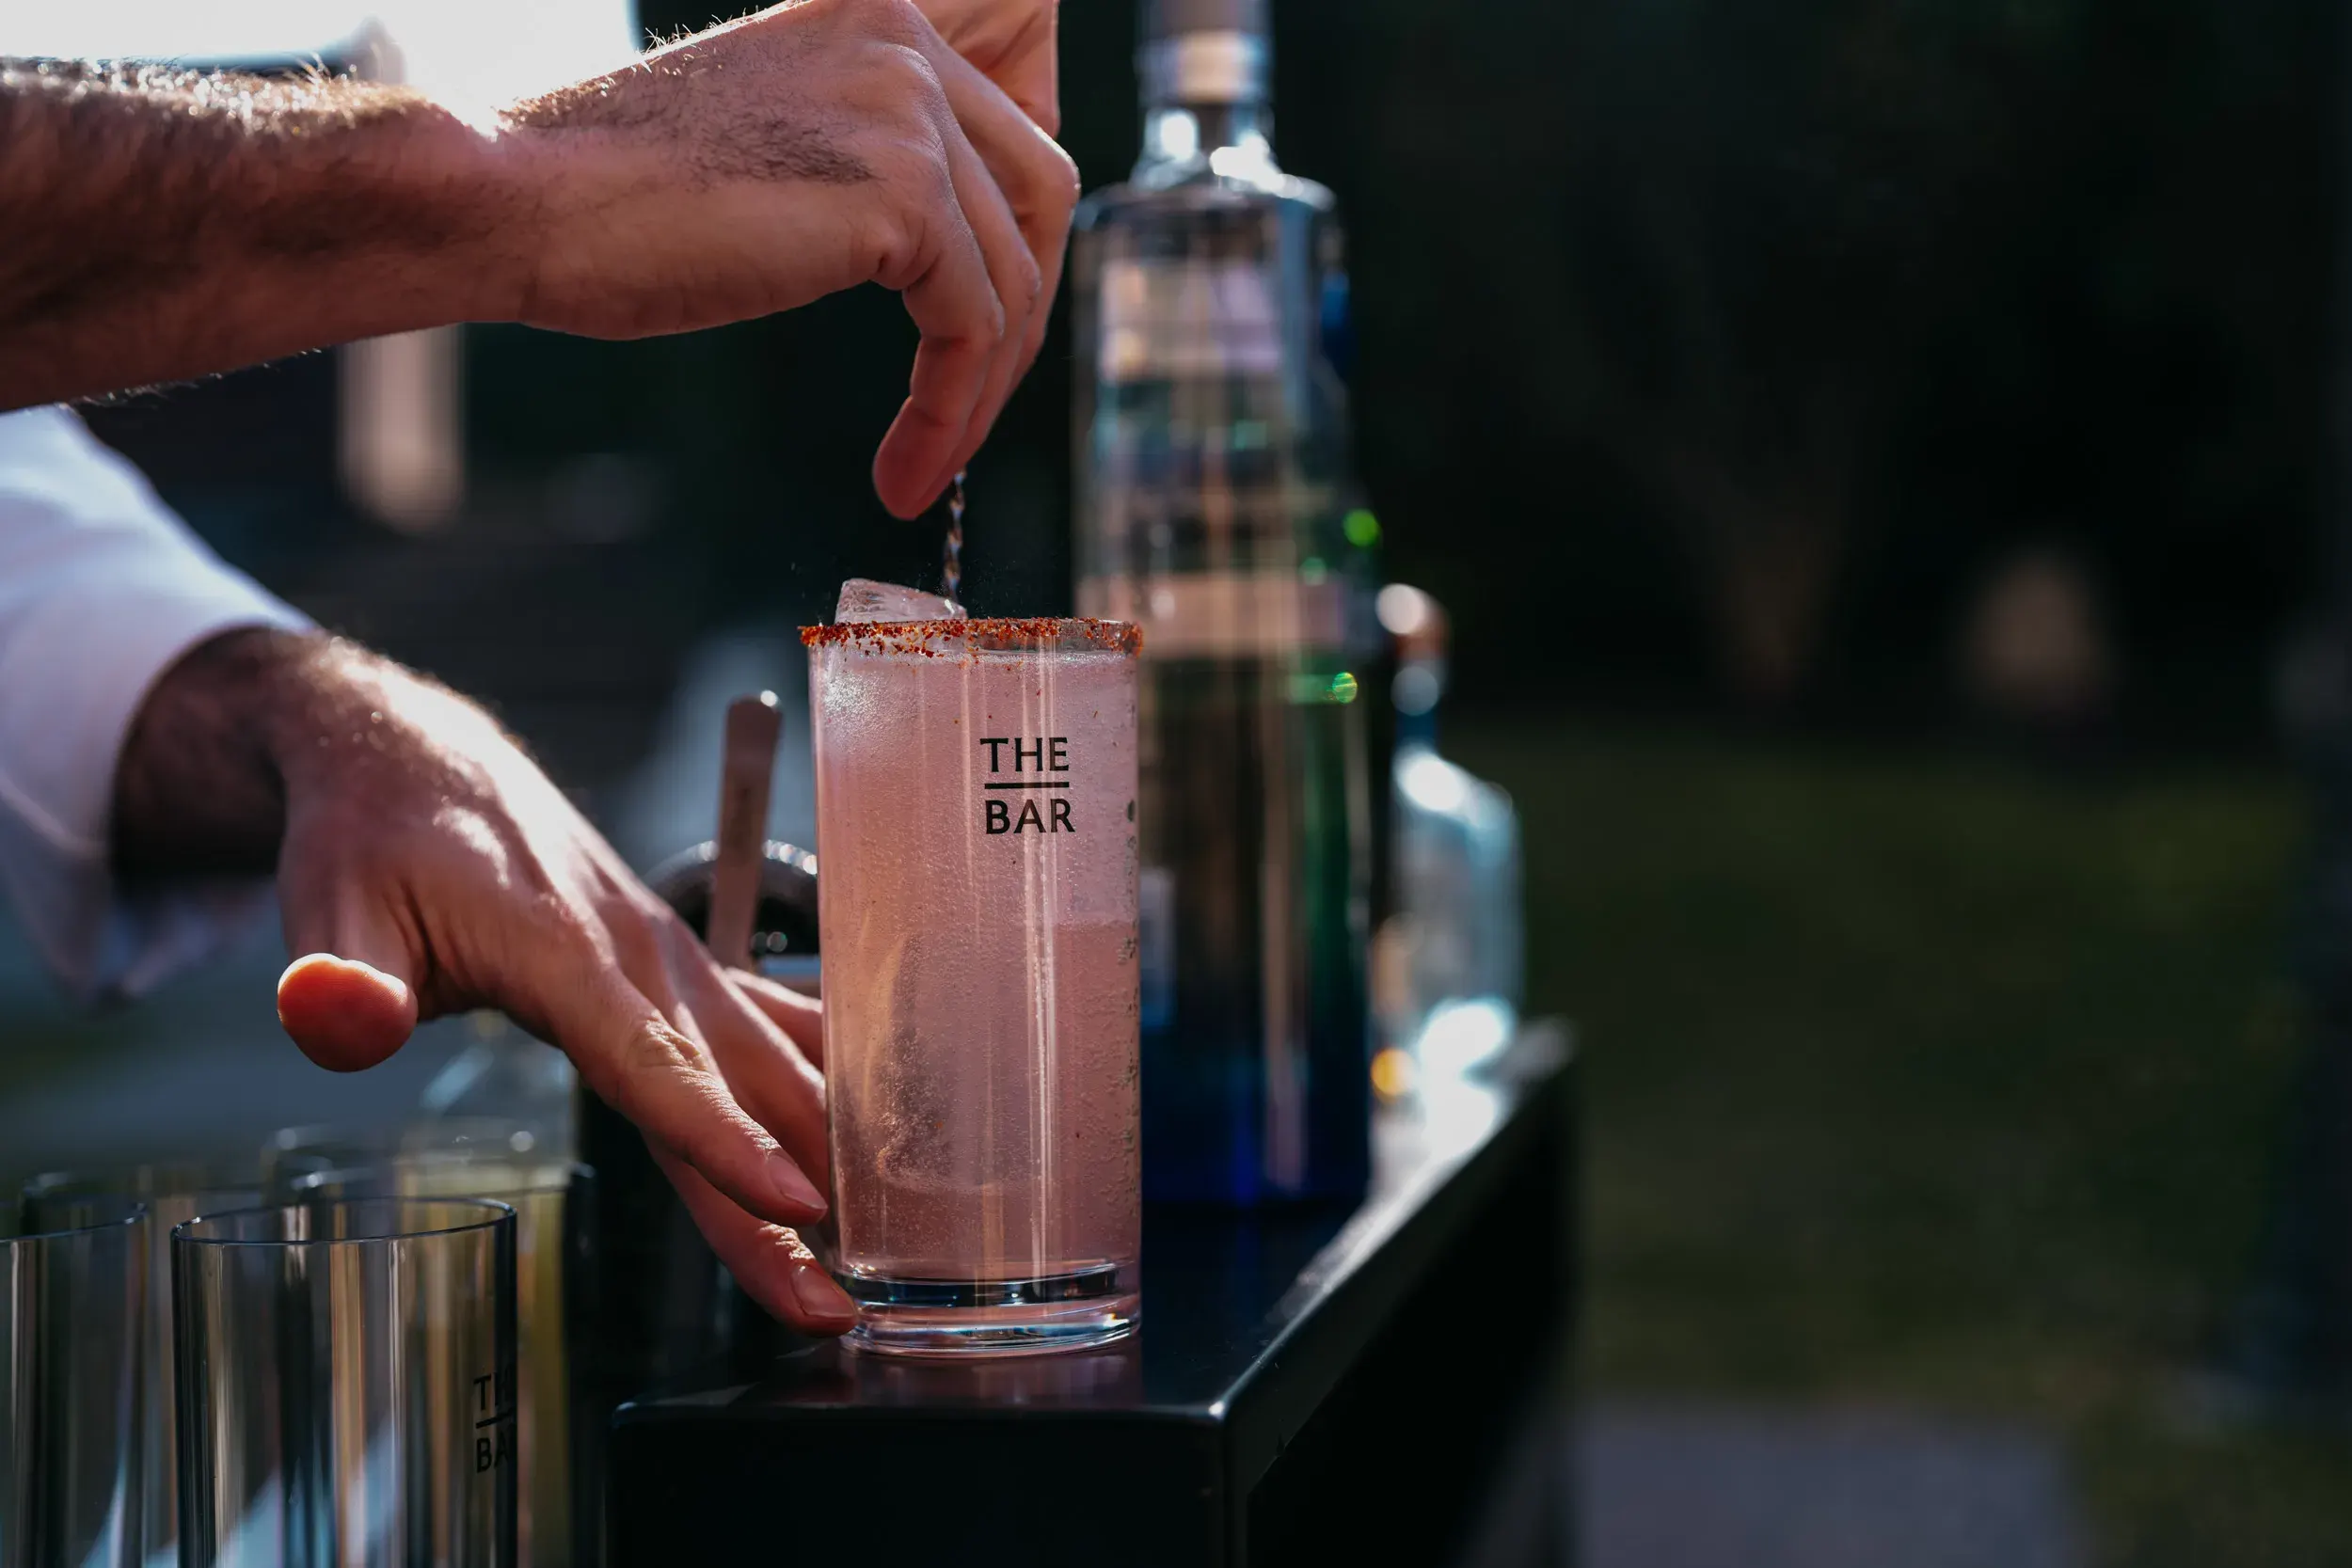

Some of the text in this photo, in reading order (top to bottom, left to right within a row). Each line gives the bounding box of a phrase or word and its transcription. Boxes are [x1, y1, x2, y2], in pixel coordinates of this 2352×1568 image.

[979, 736, 1070, 773] THE
[984, 798, 1075, 835] BAR
[476, 1428, 513, 1474] BA
